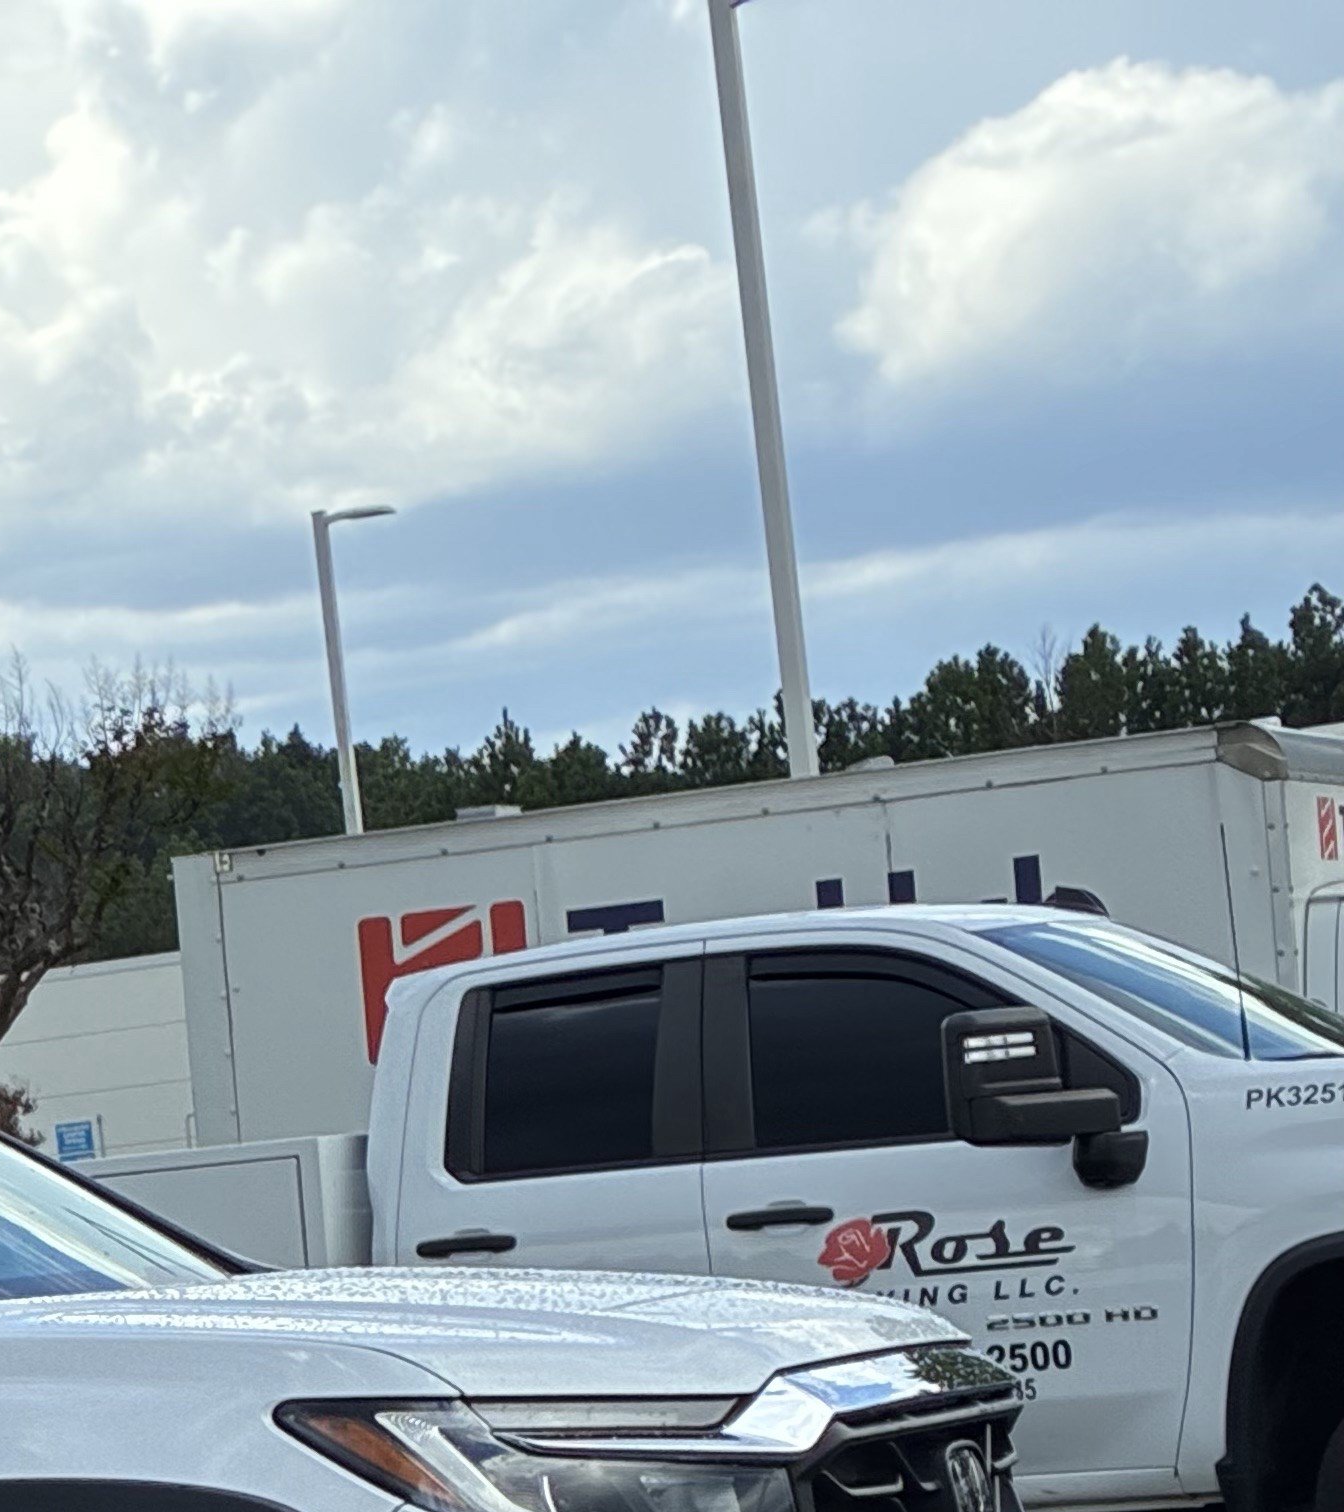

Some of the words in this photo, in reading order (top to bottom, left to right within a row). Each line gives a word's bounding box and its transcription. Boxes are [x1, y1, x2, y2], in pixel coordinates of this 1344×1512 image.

[871, 1210, 1076, 1277] Rose
[994, 1275, 1079, 1300] LLC.
[986, 1309, 1091, 1331] 2500
[1105, 1304, 1159, 1322] HD
